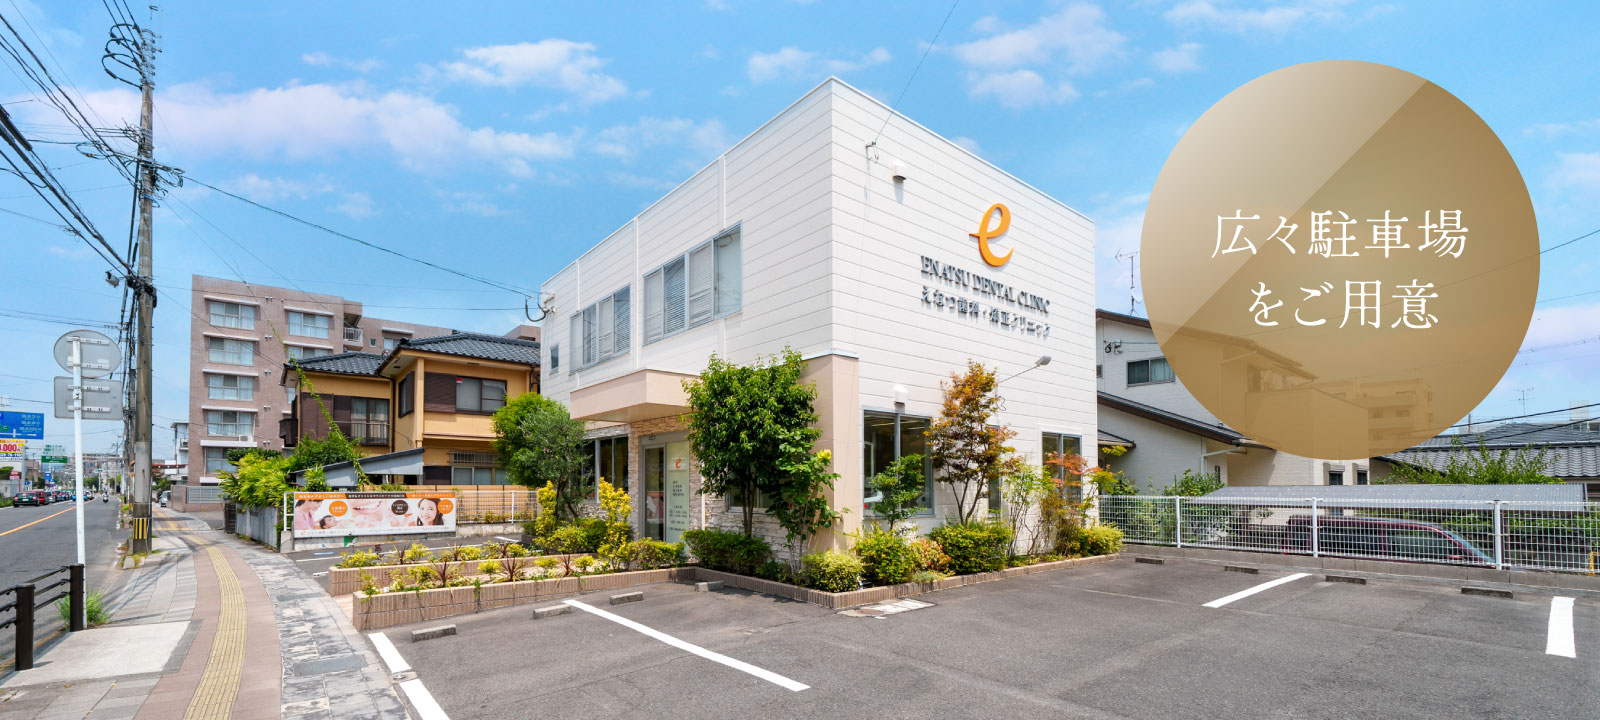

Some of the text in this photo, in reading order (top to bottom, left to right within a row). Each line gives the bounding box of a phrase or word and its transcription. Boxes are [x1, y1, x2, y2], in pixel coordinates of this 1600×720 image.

[969, 203, 1014, 267] e
[921, 255, 1050, 314] ENATSU DENTAL CLINIC
